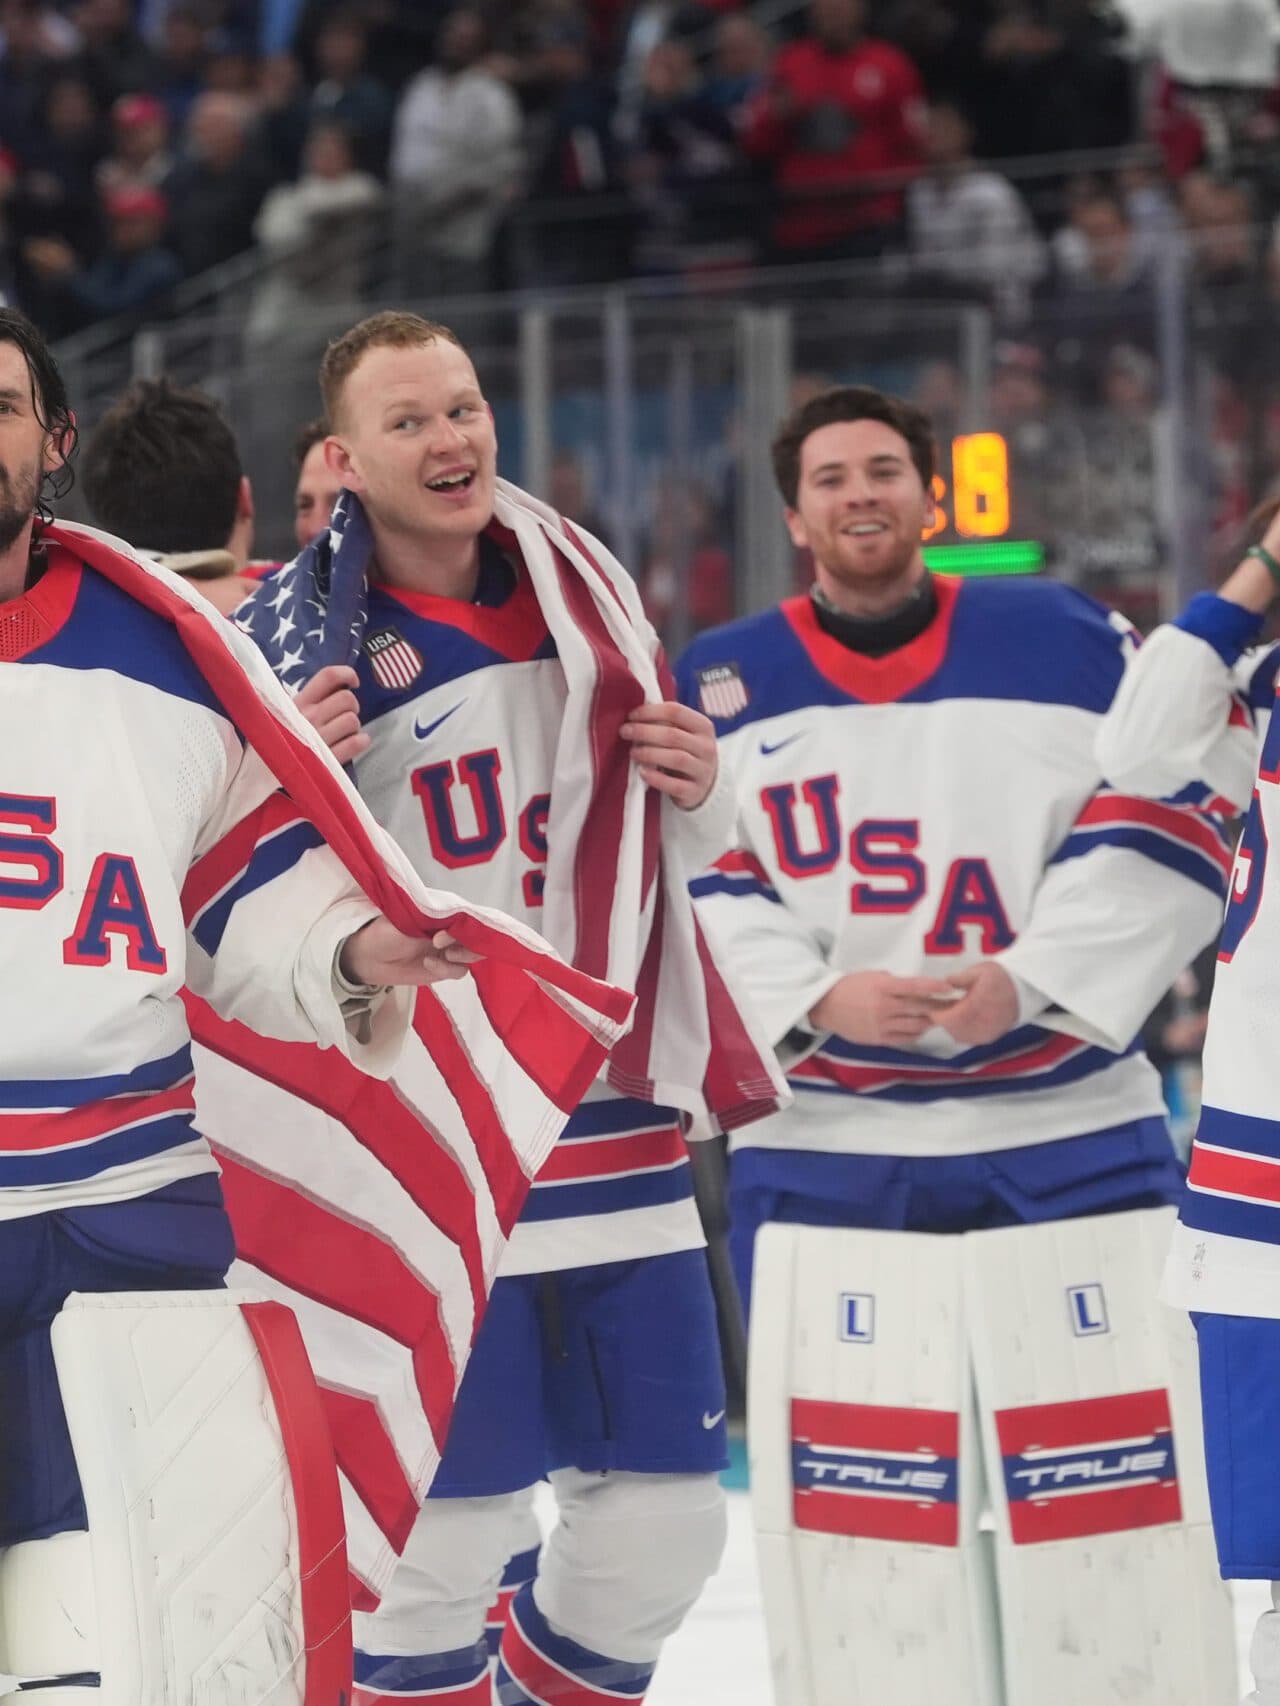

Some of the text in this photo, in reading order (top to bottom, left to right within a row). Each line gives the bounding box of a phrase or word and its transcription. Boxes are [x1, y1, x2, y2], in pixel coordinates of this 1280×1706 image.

[367, 632, 397, 652] USA
[759, 773, 1018, 956] USA
[847, 1299, 867, 1336] L
[1075, 1292, 1102, 1329] L
[800, 1461, 948, 1489] TRUE
[1012, 1451, 1169, 1486] TRUE
